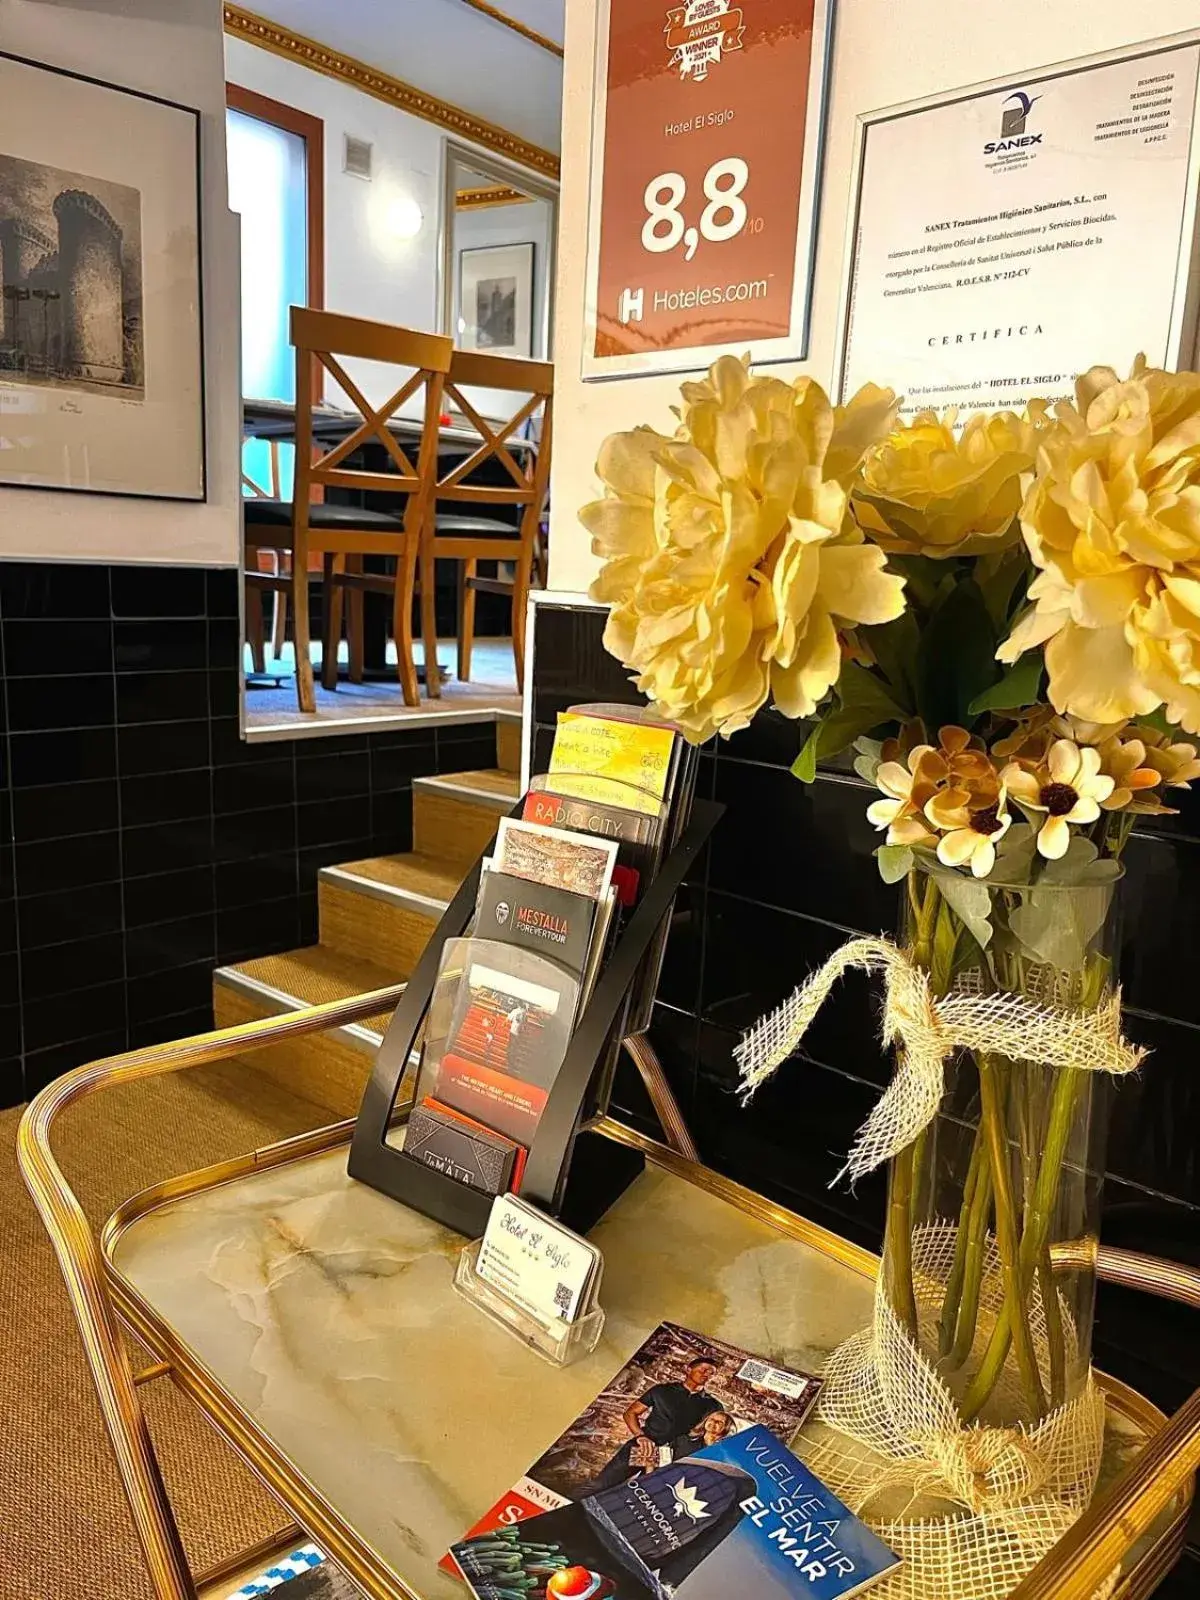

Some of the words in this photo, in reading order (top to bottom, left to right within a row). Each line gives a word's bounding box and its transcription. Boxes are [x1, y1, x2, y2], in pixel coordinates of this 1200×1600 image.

[685, 37, 719, 55] WINNER
[689, 20, 721, 39] AWARD
[665, 119, 693, 137] Hotel
[695, 114, 705, 129] El
[707, 109, 735, 127] Siglo
[983, 133, 1043, 154] SANEX
[640, 156, 749, 262] 8,8
[924, 222, 951, 233] SANEX
[952, 214, 998, 229] Tratamientos
[999, 206, 1033, 220] Higiénico
[1034, 199, 1072, 214] Sanitarios,
[1093, 193, 1107, 201] con
[911, 248, 919, 256] en
[919, 246, 926, 254] el
[926, 242, 953, 255] Registro
[953, 237, 976, 249] Oficial
[977, 235, 986, 244] de
[986, 227, 1041, 243] Establecimientos
[1048, 219, 1082, 231] Servicios
[912, 266, 924, 276] por
[924, 264, 931, 273] la
[967, 257, 976, 266] de
[976, 254, 1000, 265] Sanitat
[1000, 248, 1033, 261] Universal
[1056, 239, 1084, 251] Pública
[1084, 238, 1095, 246] de
[1095, 236, 1103, 245] la
[653, 277, 768, 313] Hoteles.com
[908, 386, 921, 396] Que
[922, 385, 932, 394] las
[932, 382, 971, 394] instalaciones
[971, 380, 982, 390] del
[989, 377, 1020, 388] HOTEL
[1020, 375, 1033, 386] EL
[1033, 373, 1062, 385] SIGLO
[967, 400, 996, 410] Valencia
[999, 398, 1011, 408] han
[1012, 397, 1027, 406] sido
[534, 801, 584, 826] RADIO
[588, 815, 624, 838] CITY
[516, 921, 568, 945] FOREVERTOUR
[518, 906, 570, 934] MESTALLA
[500, 1213, 529, 1240] Hotel
[528, 1232, 543, 1249] El
[545, 1243, 571, 1270] Siglo
[746, 1437, 826, 1516] VUELVE
[817, 1520, 841, 1537] A
[739, 1495, 770, 1528] EL
[768, 1527, 827, 1582] MAR
[769, 1496, 856, 1578] SENTIR
